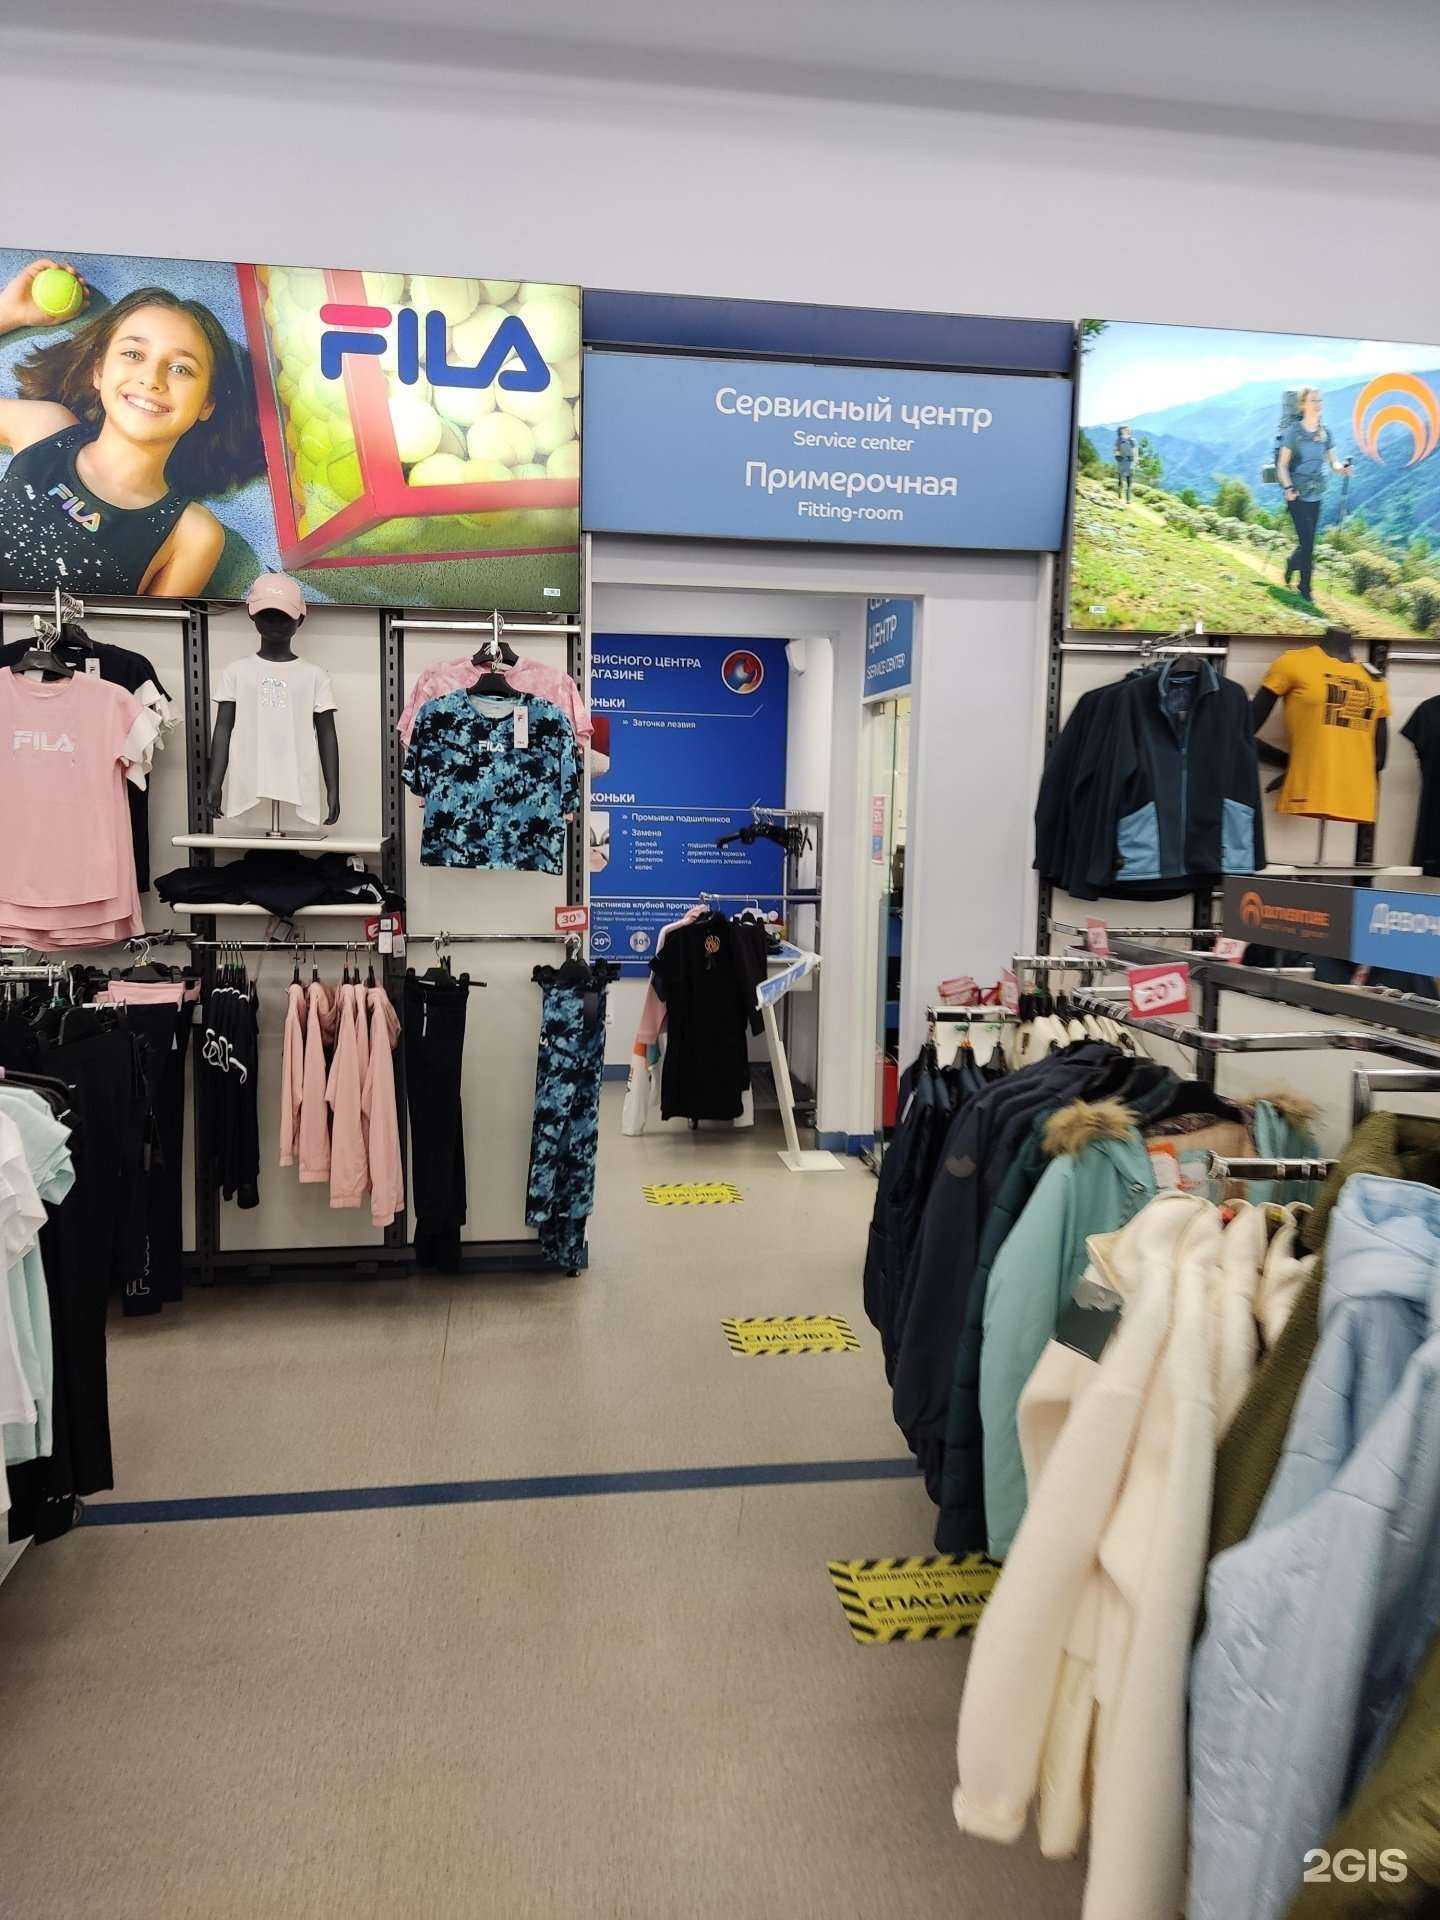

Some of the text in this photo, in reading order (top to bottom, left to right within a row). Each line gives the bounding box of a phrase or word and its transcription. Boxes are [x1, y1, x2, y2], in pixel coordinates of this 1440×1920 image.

[320, 304, 551, 392] FILA
[715, 386, 994, 433] Сервисный центр
[793, 430, 915, 452] Service center
[744, 461, 958, 498] Примерочная
[48, 483, 101, 533] FILA
[798, 501, 905, 523] Fitting-room
[869, 614, 898, 654] ЦЕНТР
[590, 654, 702, 669] ВИСНОГО ЦЕНТРА
[590, 669, 645, 681] АГАЗИНЕ
[632, 718, 665, 728] Заточка
[13, 730, 76, 753] FILA
[478, 740, 505, 753] FILA
[631, 812, 731, 824] Промывка подшипников
[631, 828, 663, 837] Замена
[632, 901, 665, 911] клубной
